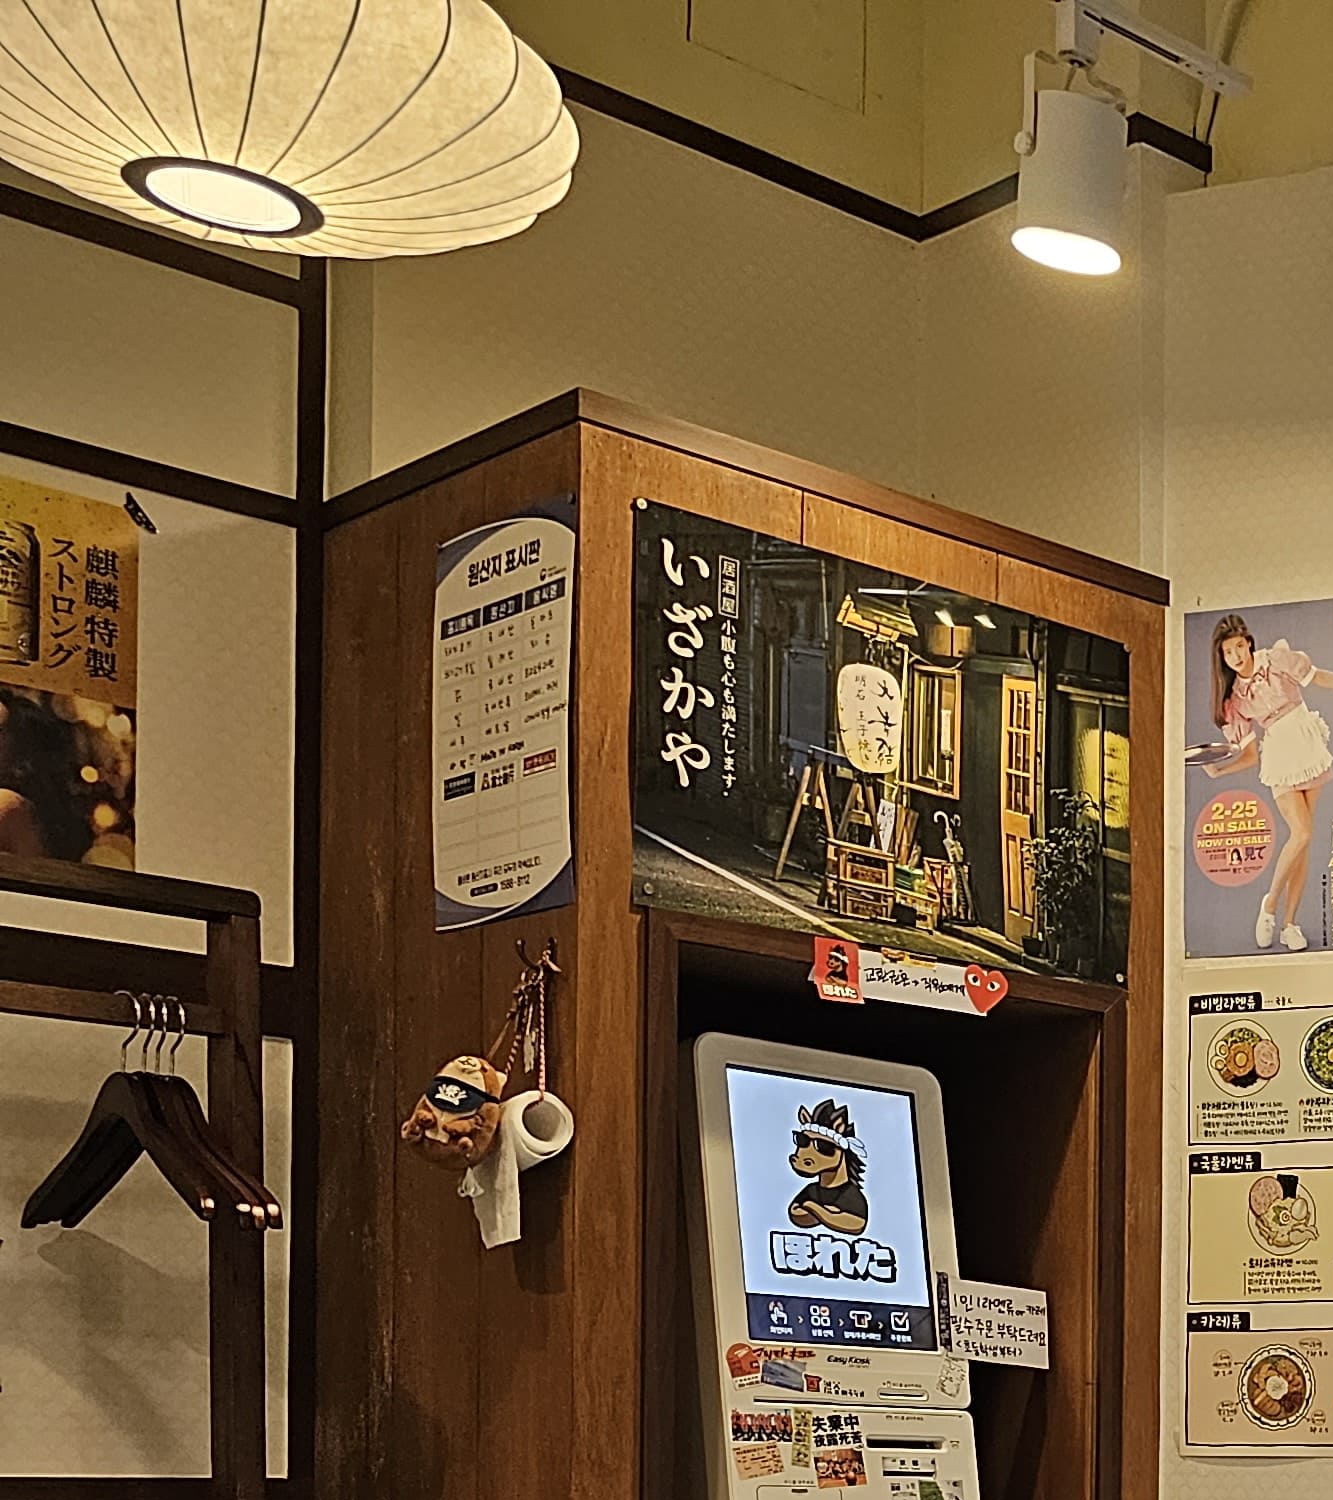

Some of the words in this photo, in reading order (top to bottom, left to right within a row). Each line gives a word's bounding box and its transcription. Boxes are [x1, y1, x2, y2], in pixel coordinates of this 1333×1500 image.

[468, 553, 502, 588] 원산지
[504, 538, 541, 574] 표시판
[48, 537, 81, 669] ストロング
[85, 544, 120, 682] 麒麟特製
[660, 537, 715, 788] いざかや
[1211, 801, 1258, 820] 2-25
[1202, 823, 1225, 834] ON
[1226, 819, 1267, 833] SALE
[1197, 838, 1224, 848] NOW
[1225, 837, 1242, 847] ON
[1243, 834, 1272, 845] SALE
[1200, 995, 1255, 1010] 비빔라멘류
[1199, 1155, 1254, 1170] 국물라멘류
[770, 1231, 902, 1284] ほれた
[1200, 1315, 1242, 1329] 카레류
[827, 1355, 847, 1365] Easy
[848, 1356, 871, 1365] Kiosk
